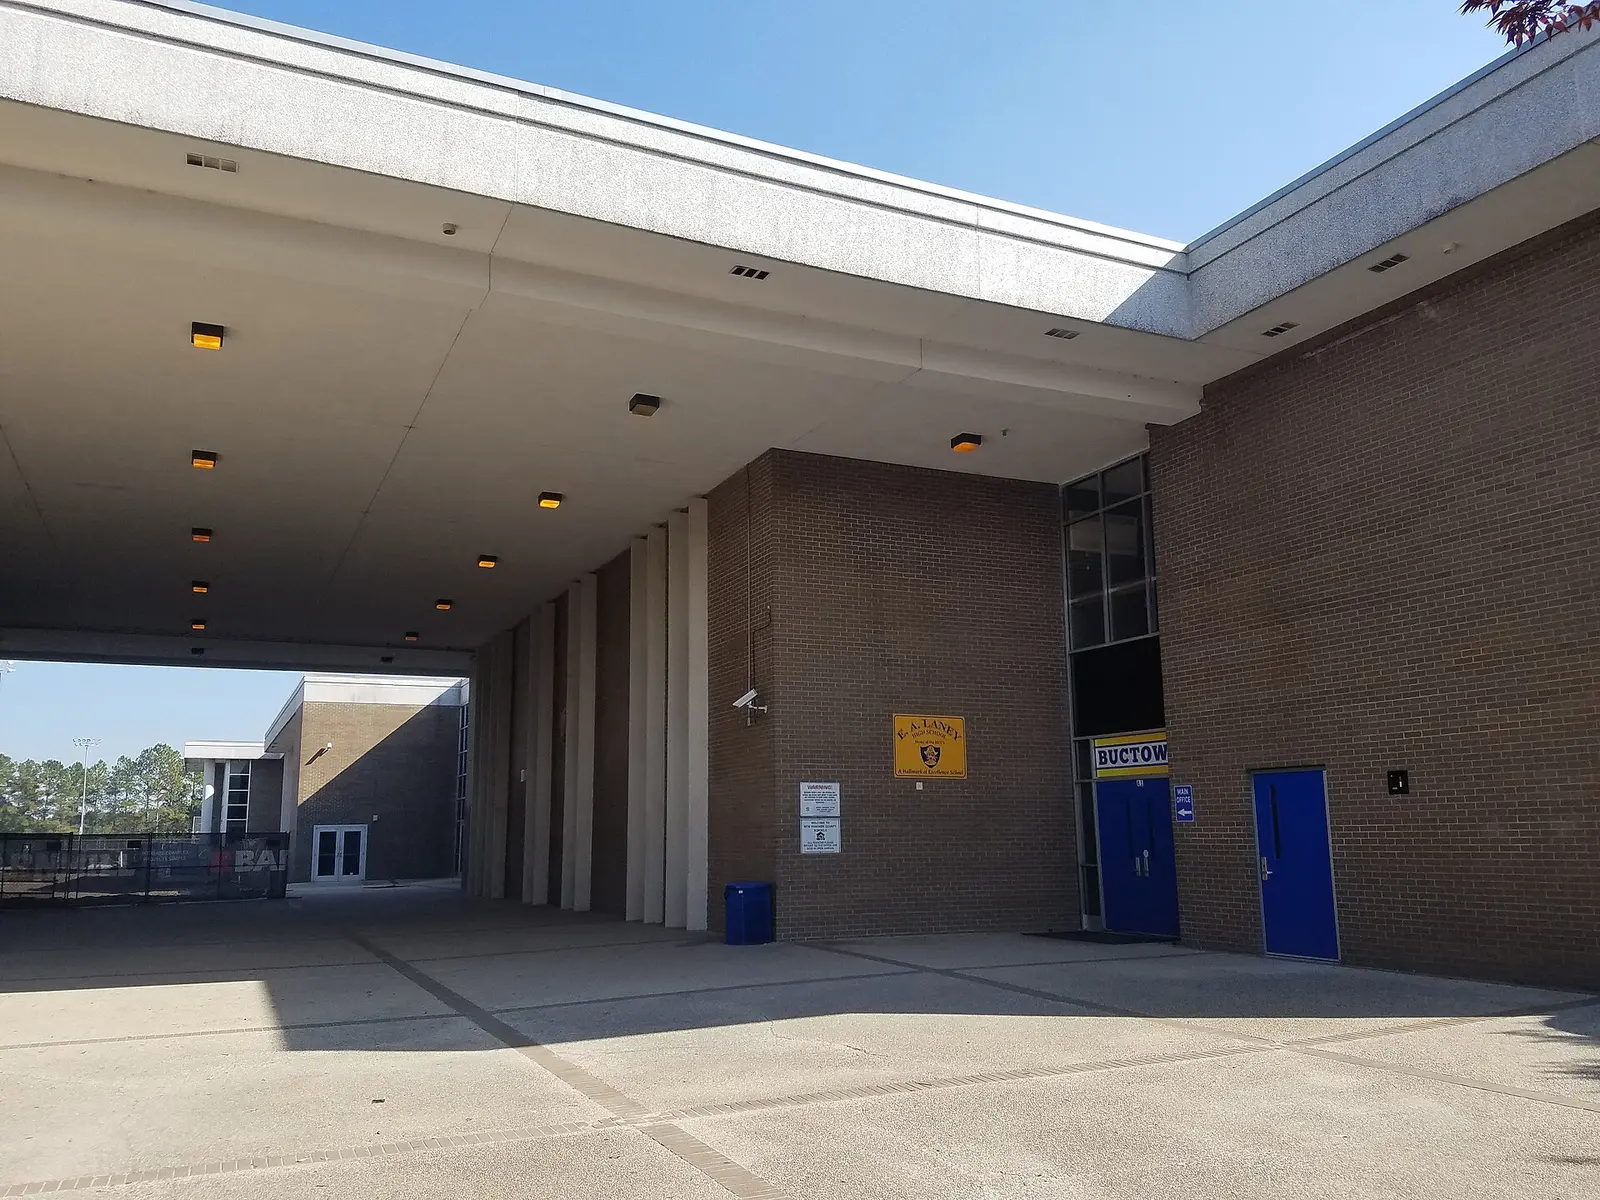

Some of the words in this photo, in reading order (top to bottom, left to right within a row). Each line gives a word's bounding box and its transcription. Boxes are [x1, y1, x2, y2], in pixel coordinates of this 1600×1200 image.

[911, 730, 925, 738] HIGH
[926, 730, 947, 739] SCHOOL
[921, 719, 962, 740] LANEY
